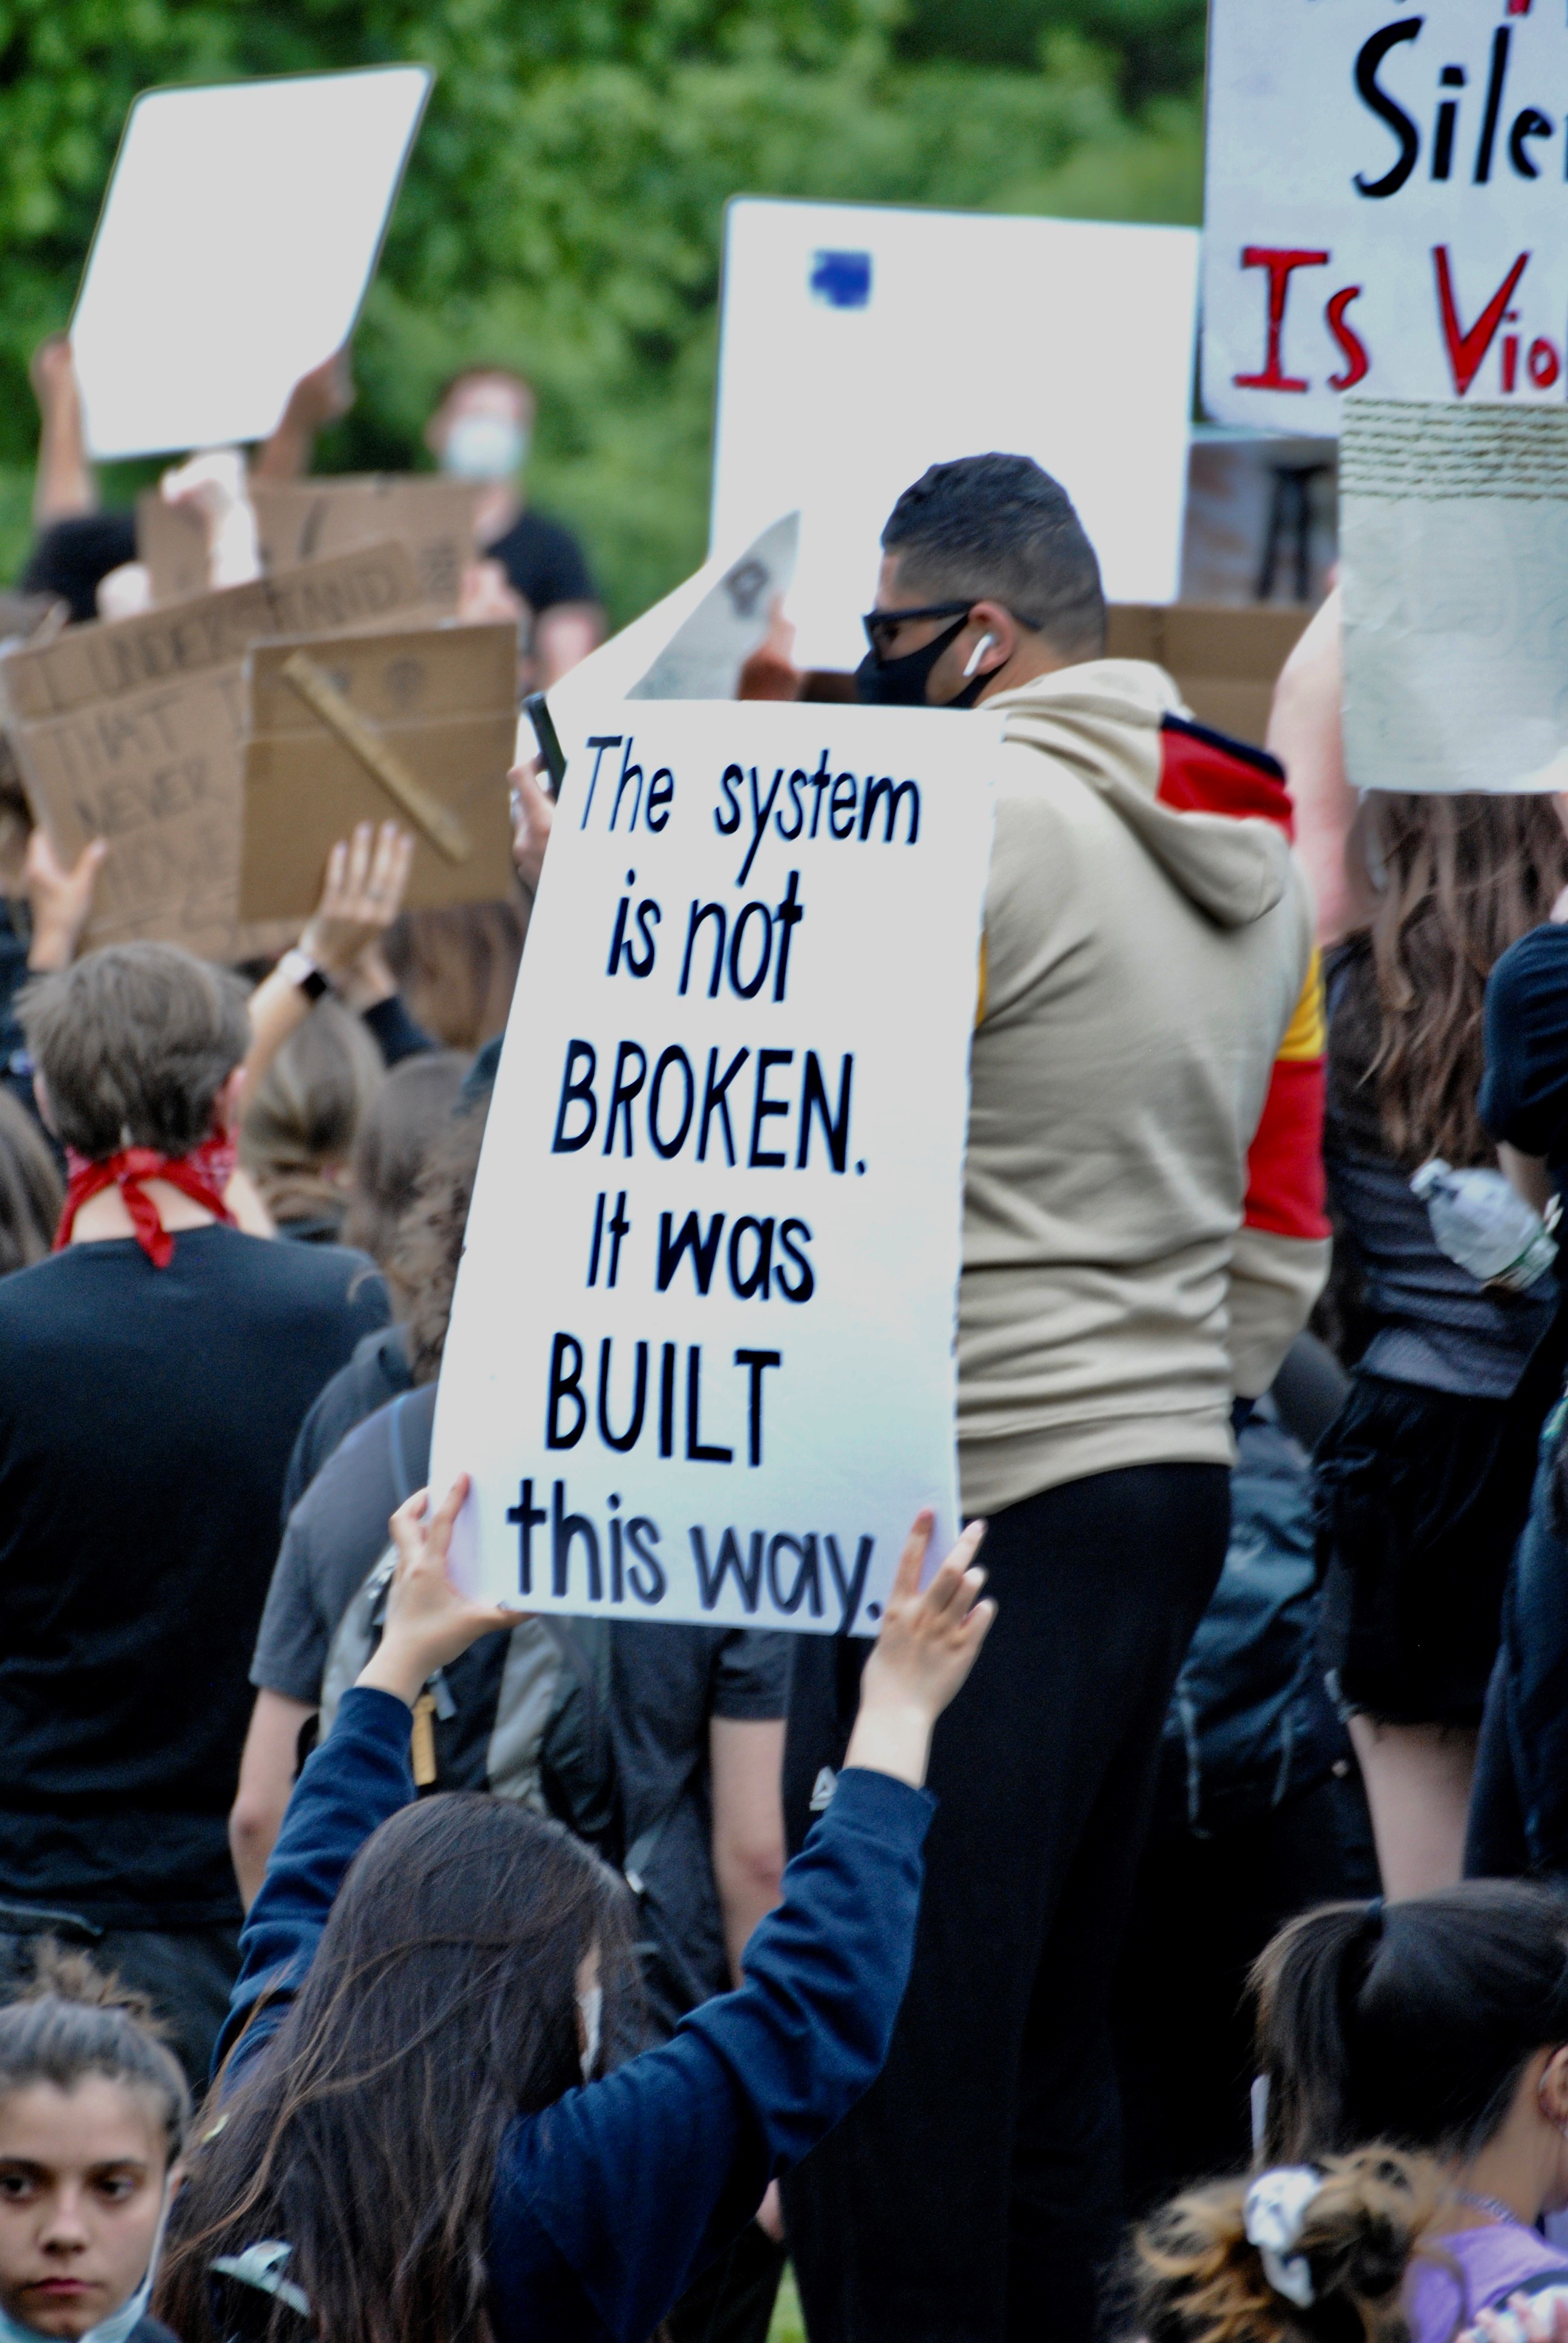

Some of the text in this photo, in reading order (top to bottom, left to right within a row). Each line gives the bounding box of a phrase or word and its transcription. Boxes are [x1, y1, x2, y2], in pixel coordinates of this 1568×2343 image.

[1352, 15, 1568, 200] Sile
[1234, 244, 1568, 398] Is Vio
[581, 735, 921, 888] The system
[606, 868, 805, 1003] is not
[550, 1038, 867, 1176] BROKEN.
[586, 1190, 815, 1304] It was
[544, 1331, 783, 1468] BUILT
[506, 1478, 883, 1637] this way.
